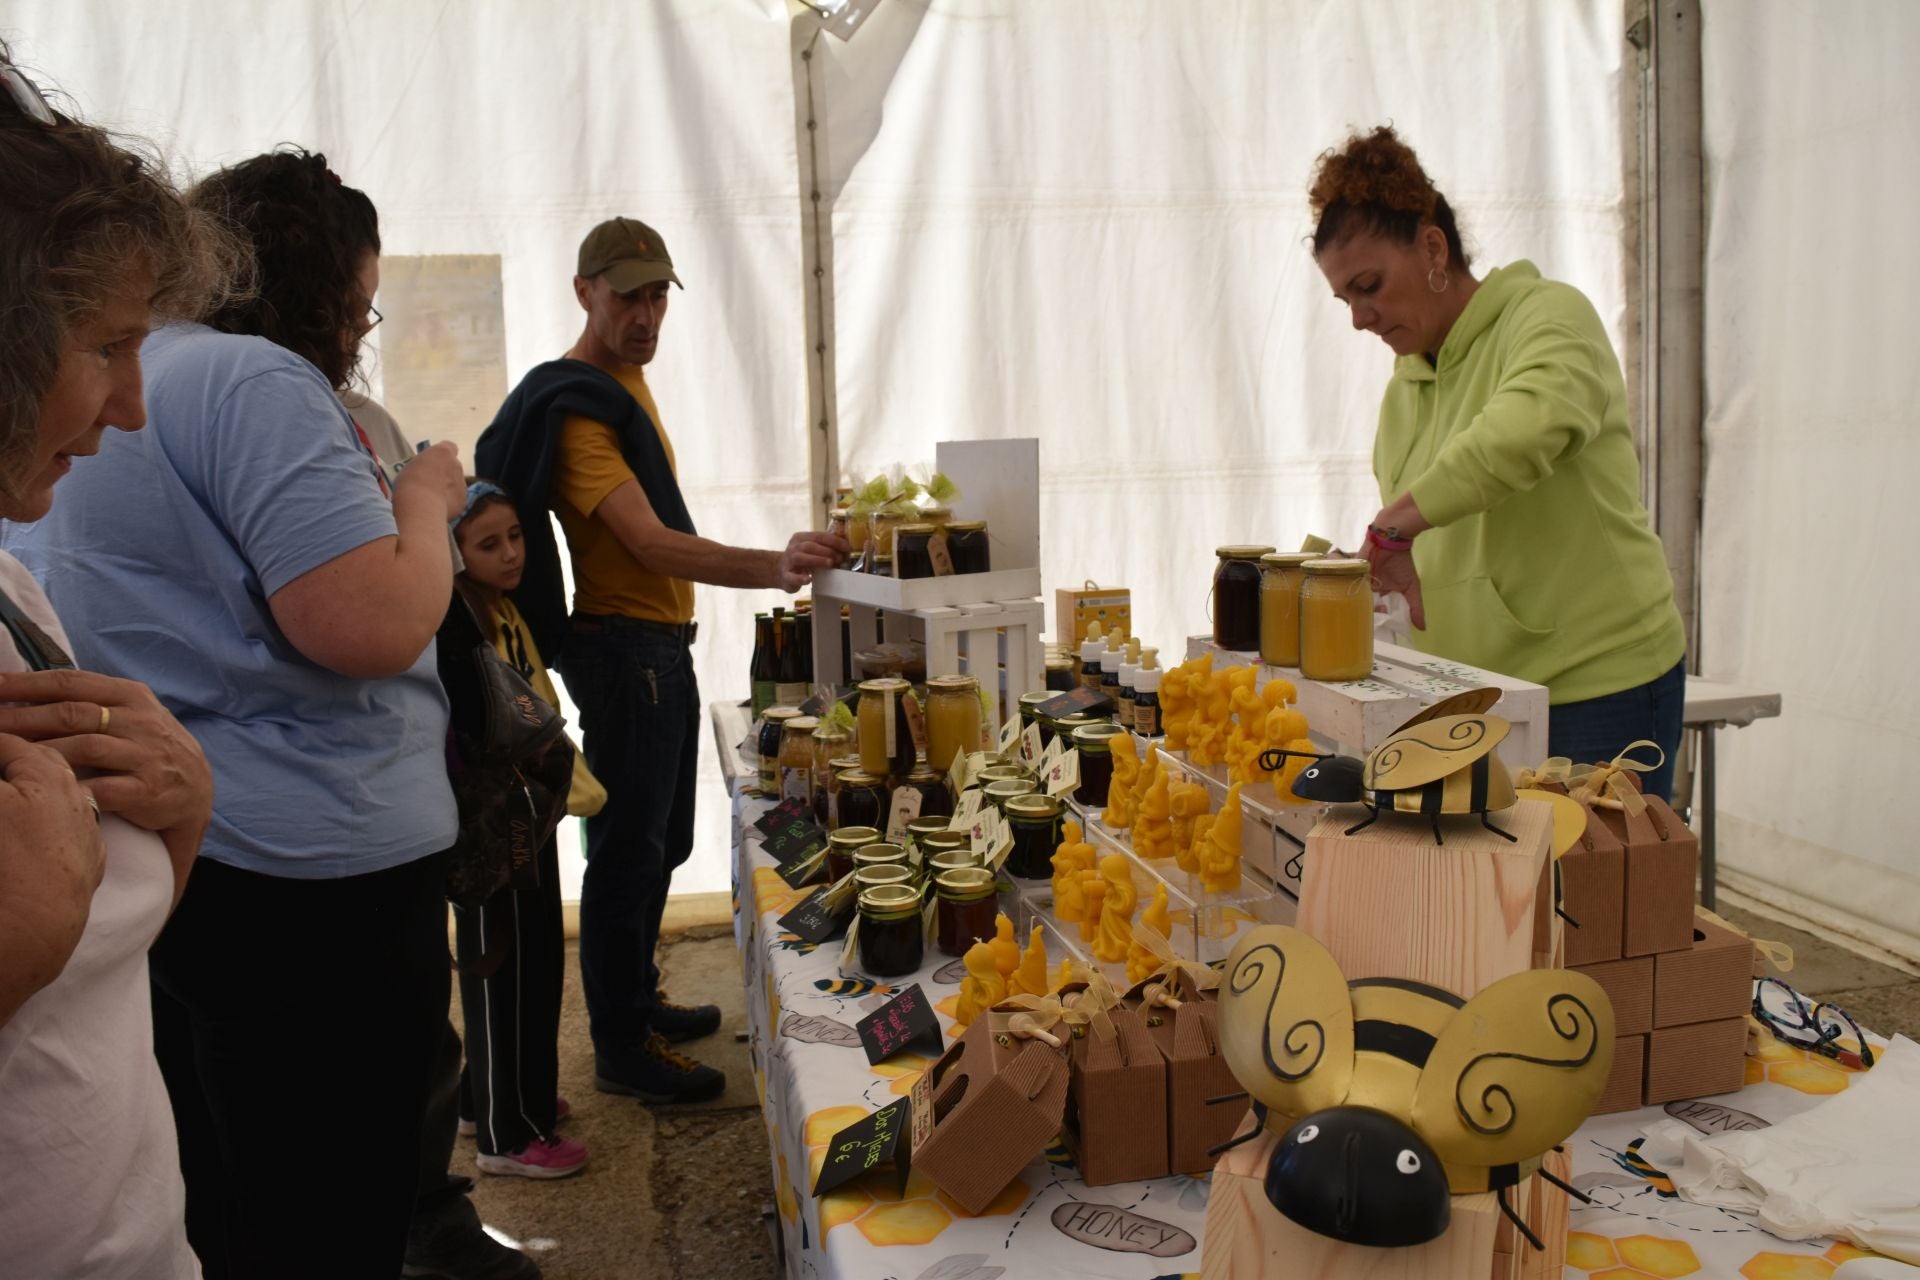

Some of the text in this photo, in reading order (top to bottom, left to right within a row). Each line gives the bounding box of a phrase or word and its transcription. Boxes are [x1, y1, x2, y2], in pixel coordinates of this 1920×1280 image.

[791, 1018, 858, 1041] HONEY
[1674, 1103, 1762, 1131] HONE
[1064, 1205, 1179, 1250] HONEY
